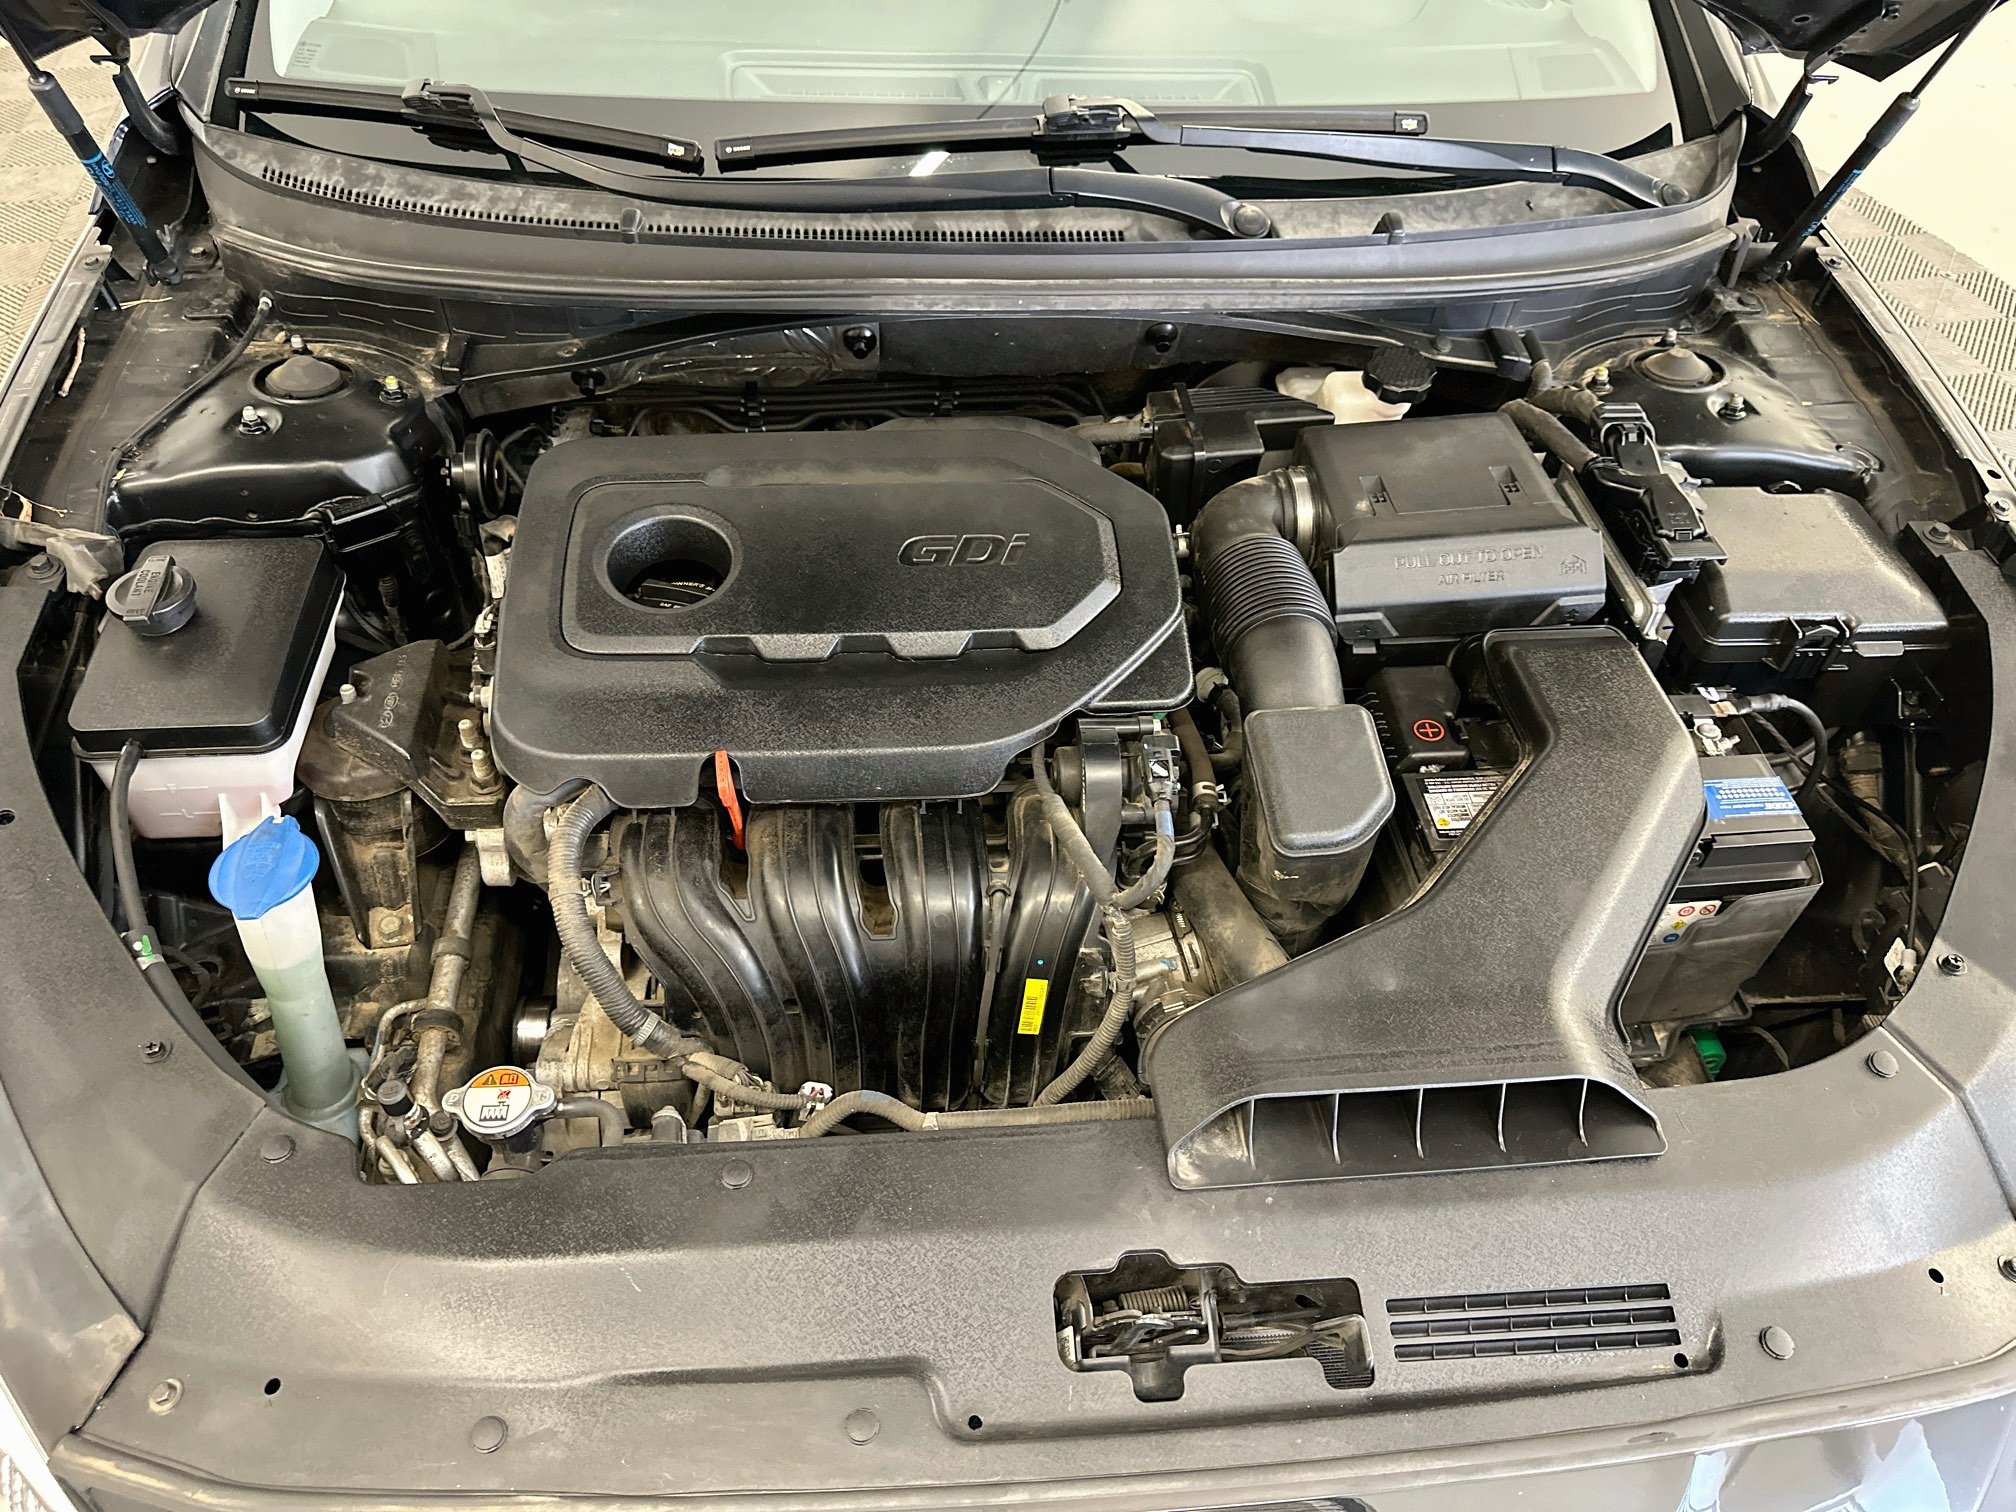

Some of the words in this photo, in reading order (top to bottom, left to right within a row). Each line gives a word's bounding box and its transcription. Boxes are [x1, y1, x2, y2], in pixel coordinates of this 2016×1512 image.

[898, 533, 1030, 567] GDi
[1394, 555, 1435, 569] PULL
[1439, 552, 1470, 566] OUT
[1477, 549, 1497, 563] TO
[1501, 545, 1543, 562] OPEN
[131, 569, 150, 596] COOLANT
[144, 571, 161, 594] ENGINE
[1438, 573, 1460, 585] AIR
[1463, 570, 1505, 583] FILTER
